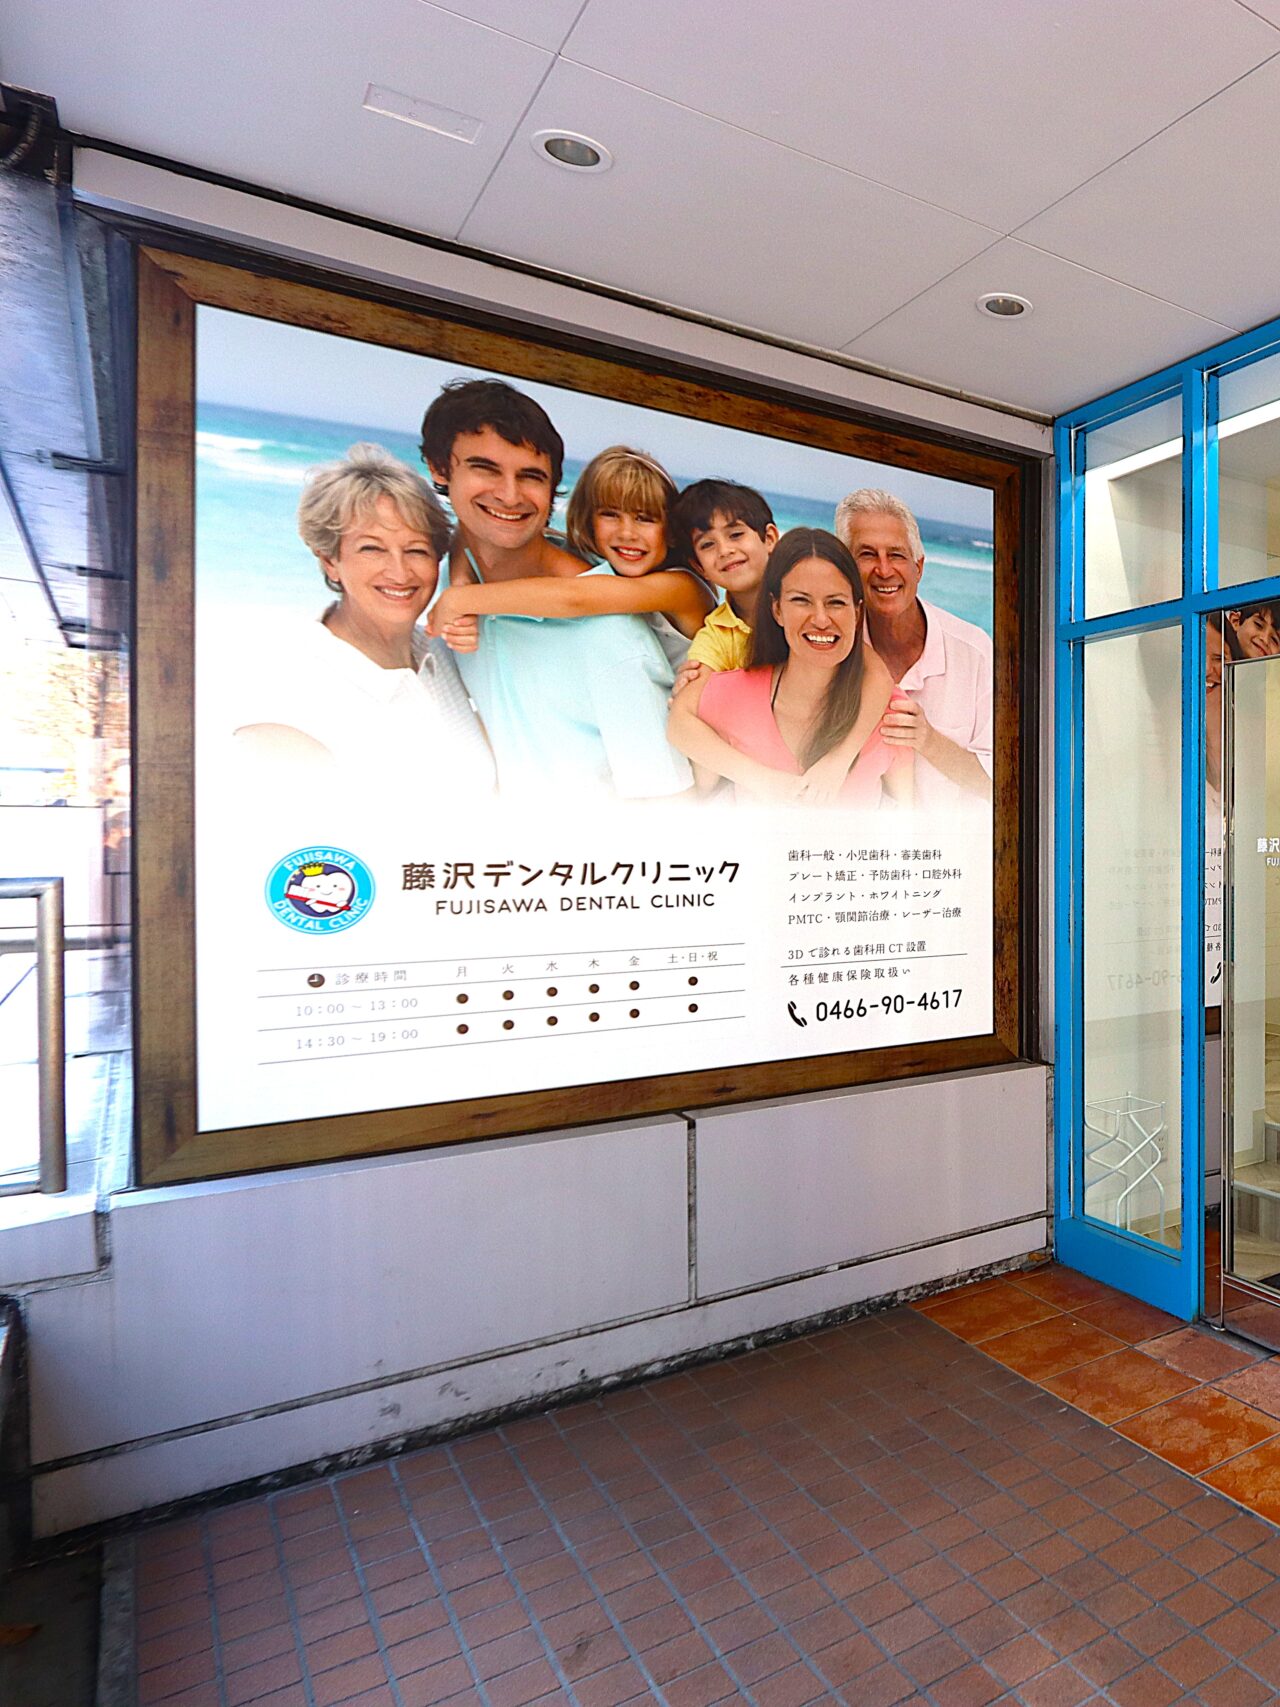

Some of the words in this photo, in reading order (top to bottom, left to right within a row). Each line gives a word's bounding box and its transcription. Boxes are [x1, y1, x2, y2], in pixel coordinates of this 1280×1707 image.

[283, 851, 357, 871] FUJISAWA
[402, 860, 740, 890] 藤沢デンタルクリニック
[273, 899, 323, 930] DENTAL
[328, 898, 368, 928] CLINIC
[435, 898, 548, 915] FUJISAWA
[560, 895, 640, 911] DENTAL
[650, 893, 715, 909] CLINIC
[336, 970, 407, 986] 診療時間
[456, 965, 467, 978] 月
[502, 964, 514, 975] 火
[546, 960, 558, 972] 水
[588, 958, 600, 969] 木
[629, 955, 640, 967] 金
[788, 966, 912, 986] 各種健康保険取扱い
[816, 989, 963, 1021] 0466-90-4617
